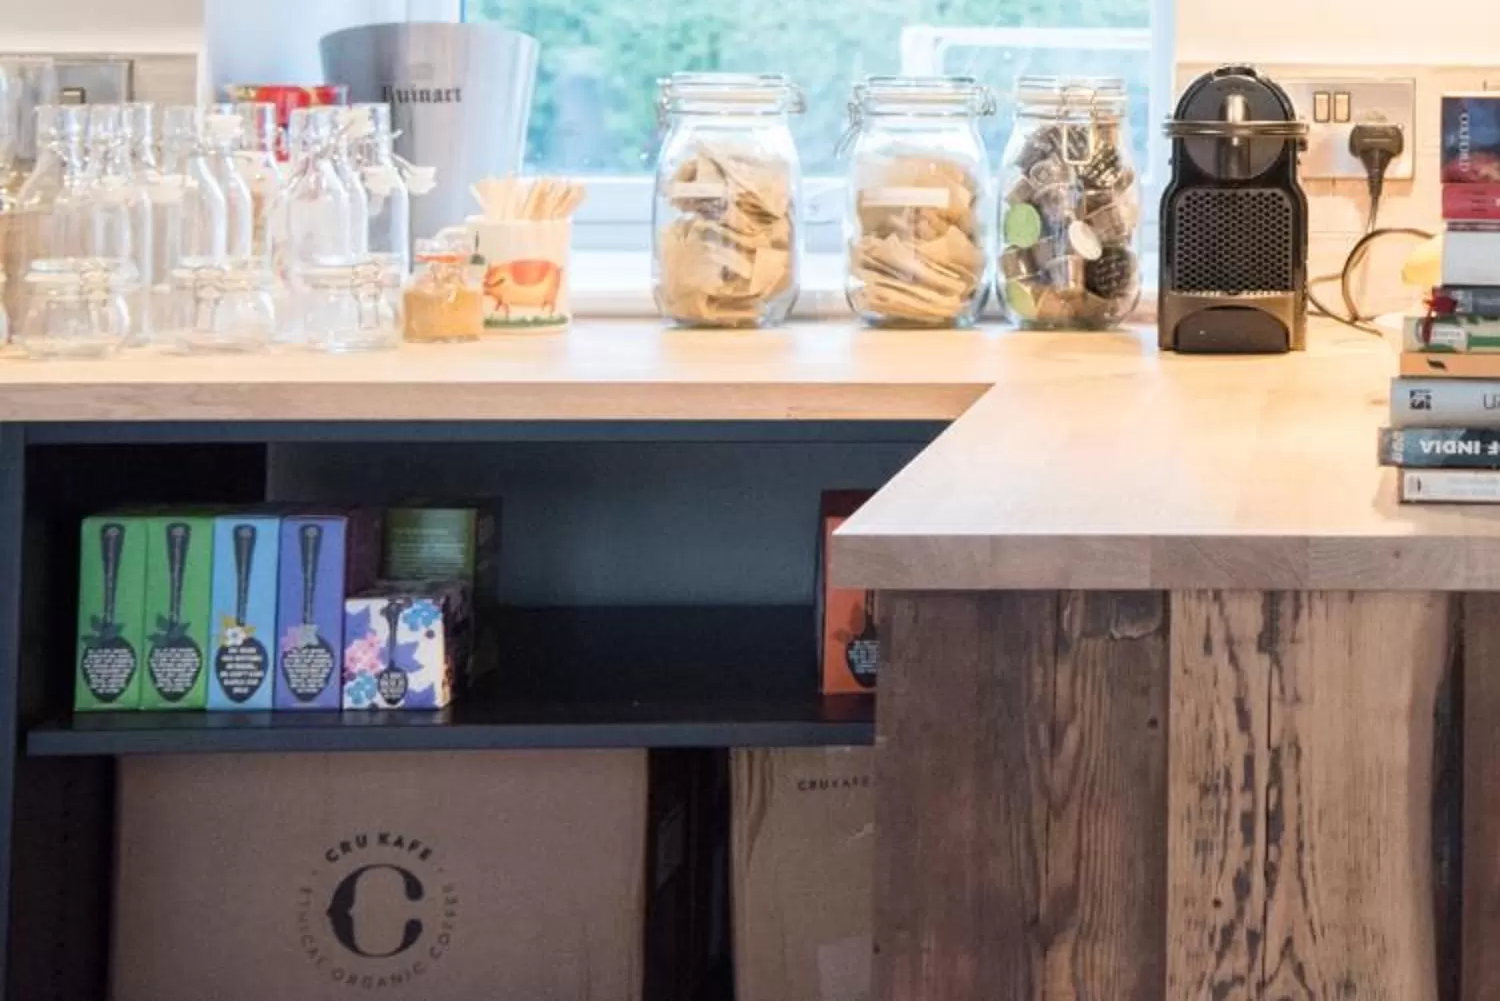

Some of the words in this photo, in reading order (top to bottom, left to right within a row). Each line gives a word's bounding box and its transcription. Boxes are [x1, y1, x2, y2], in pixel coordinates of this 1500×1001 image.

[1419, 438, 1481, 456] INDIA
[325, 834, 368, 862] CRU
[377, 832, 433, 861] KAFE
[326, 863, 424, 958] C
